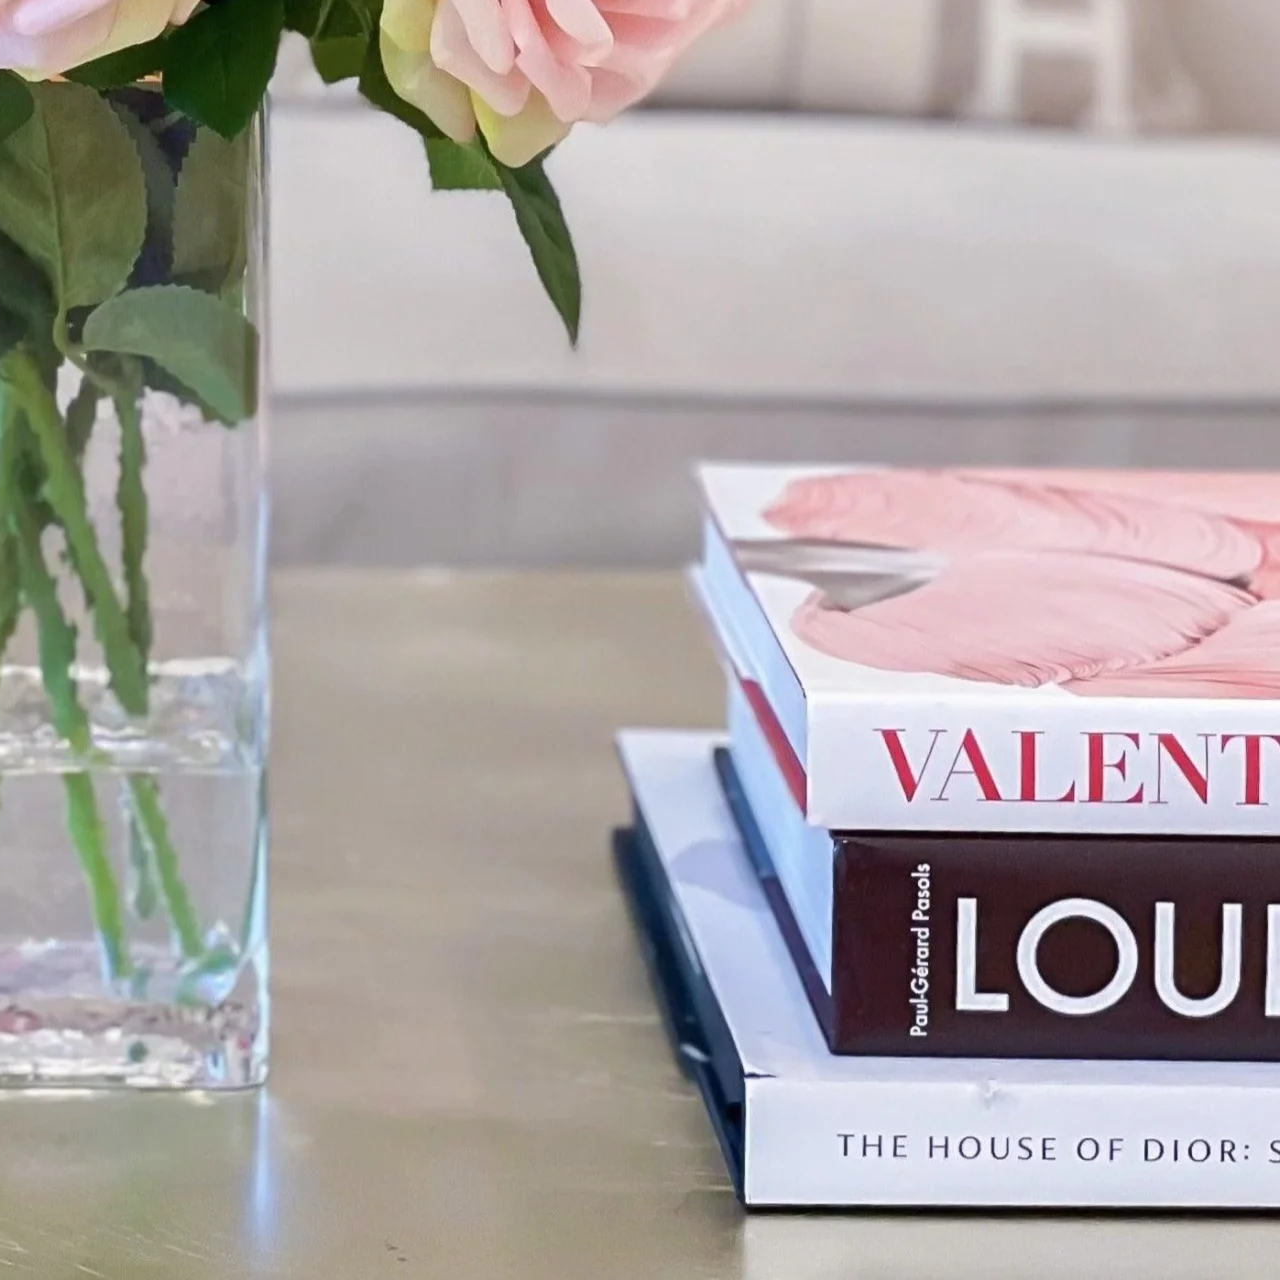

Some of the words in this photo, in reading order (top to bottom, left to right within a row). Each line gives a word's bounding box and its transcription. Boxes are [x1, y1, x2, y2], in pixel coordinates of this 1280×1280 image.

[873, 727, 1280, 806] VALENT
[910, 862, 931, 921] Pasols
[908, 927, 930, 1037] Paul-Gérard
[836, 1133, 908, 1158] THE
[928, 1135, 1056, 1161] HOUSE
[1076, 1137, 1124, 1162] OF
[1143, 1138, 1250, 1163] DIOR:
